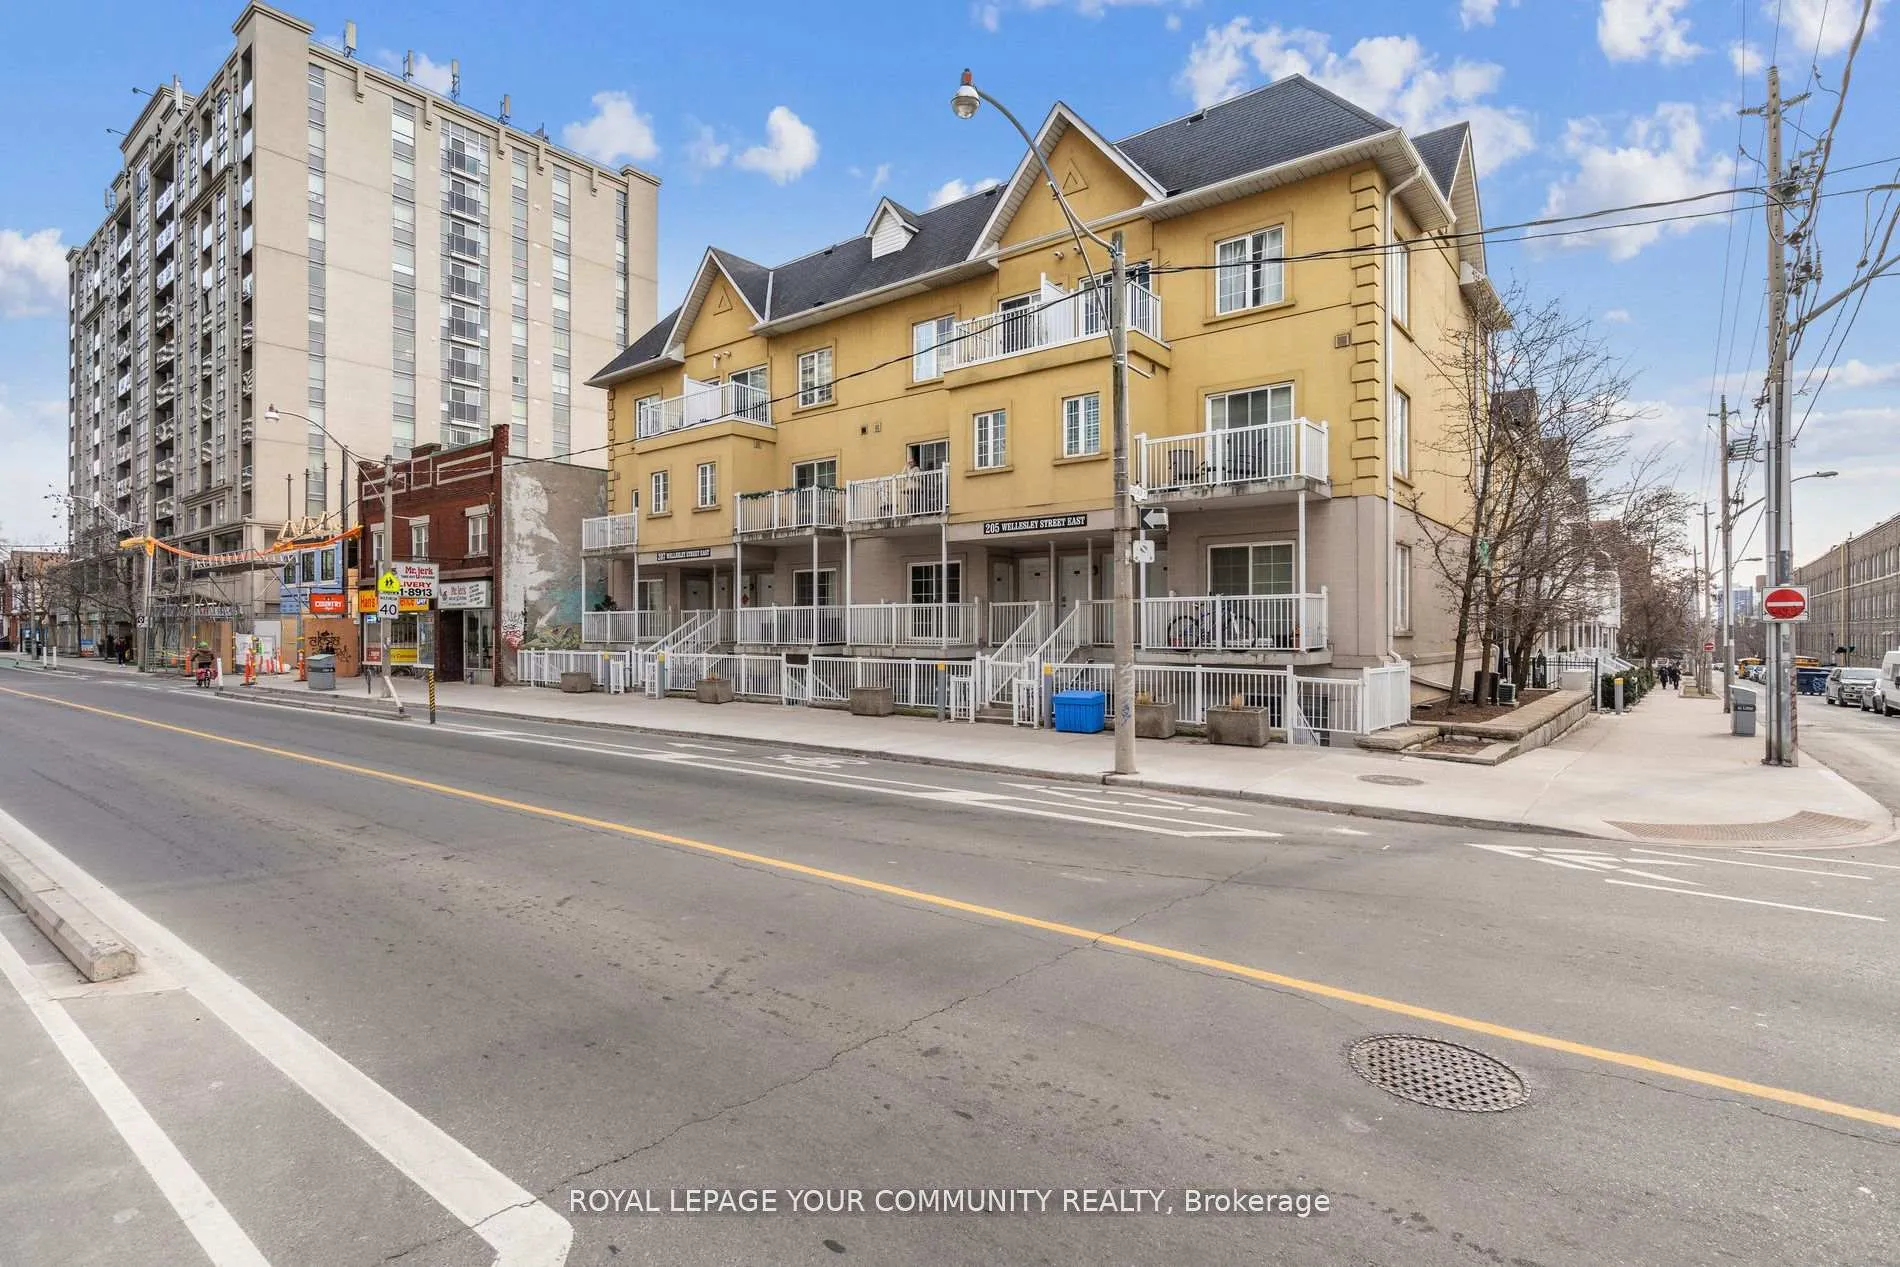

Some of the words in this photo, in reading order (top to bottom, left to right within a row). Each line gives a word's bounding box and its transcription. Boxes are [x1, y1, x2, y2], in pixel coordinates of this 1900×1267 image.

[985, 522, 1000, 534] 205
[1001, 520, 1039, 532] WELLESLEY
[1040, 518, 1066, 529] STREET
[1067, 516, 1086, 526] EAST
[380, 603, 397, 616] 40
